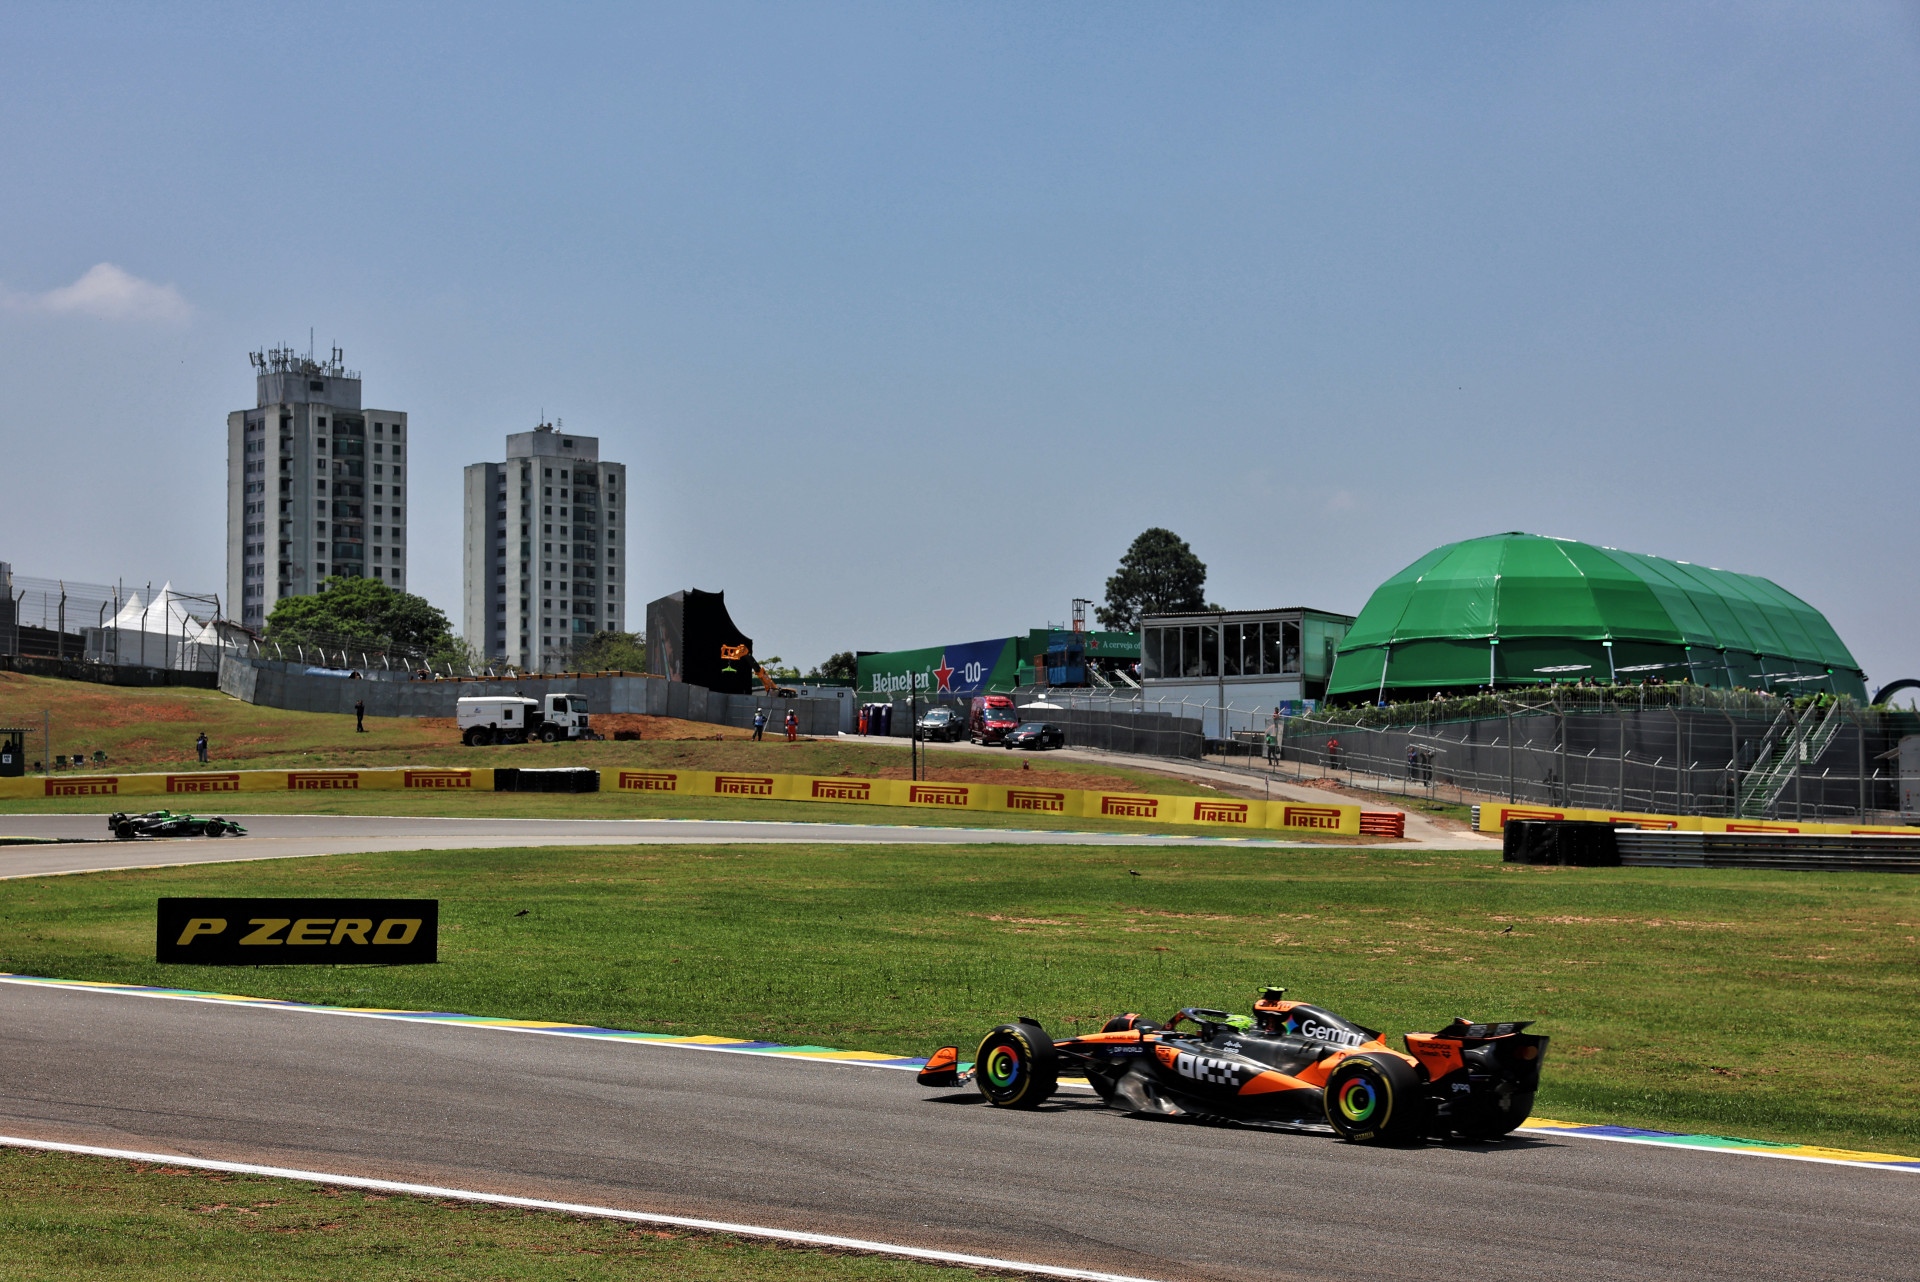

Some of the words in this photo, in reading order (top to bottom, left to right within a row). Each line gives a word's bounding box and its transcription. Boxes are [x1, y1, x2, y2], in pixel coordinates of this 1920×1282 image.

[1109, 641, 1133, 651] cerveja
[872, 669, 929, 693] Heineken
[964, 660, 981, 683] 0.0
[45, 777, 118, 796] PIRELLI
[167, 774, 240, 792] PIRELLI
[288, 772, 359, 790] PIRELLI
[404, 771, 472, 788] PIRELLI
[619, 772, 677, 791] PIRELLI
[715, 776, 773, 795] PIRELLI
[812, 780, 871, 800] PIRELLI
[910, 785, 969, 805] PIRELLI
[1007, 790, 1064, 812] PIRELLI
[1101, 796, 1158, 818] PIRELLI
[1193, 801, 1248, 823] PIRELLI
[1284, 806, 1341, 829] PIRELLI
[176, 918, 227, 945] P
[239, 918, 423, 945] ZERO
[1301, 1019, 1365, 1047] Gemini
[1418, 1040, 1452, 1050] Dropbox
[1451, 1083, 1471, 1094] groq
